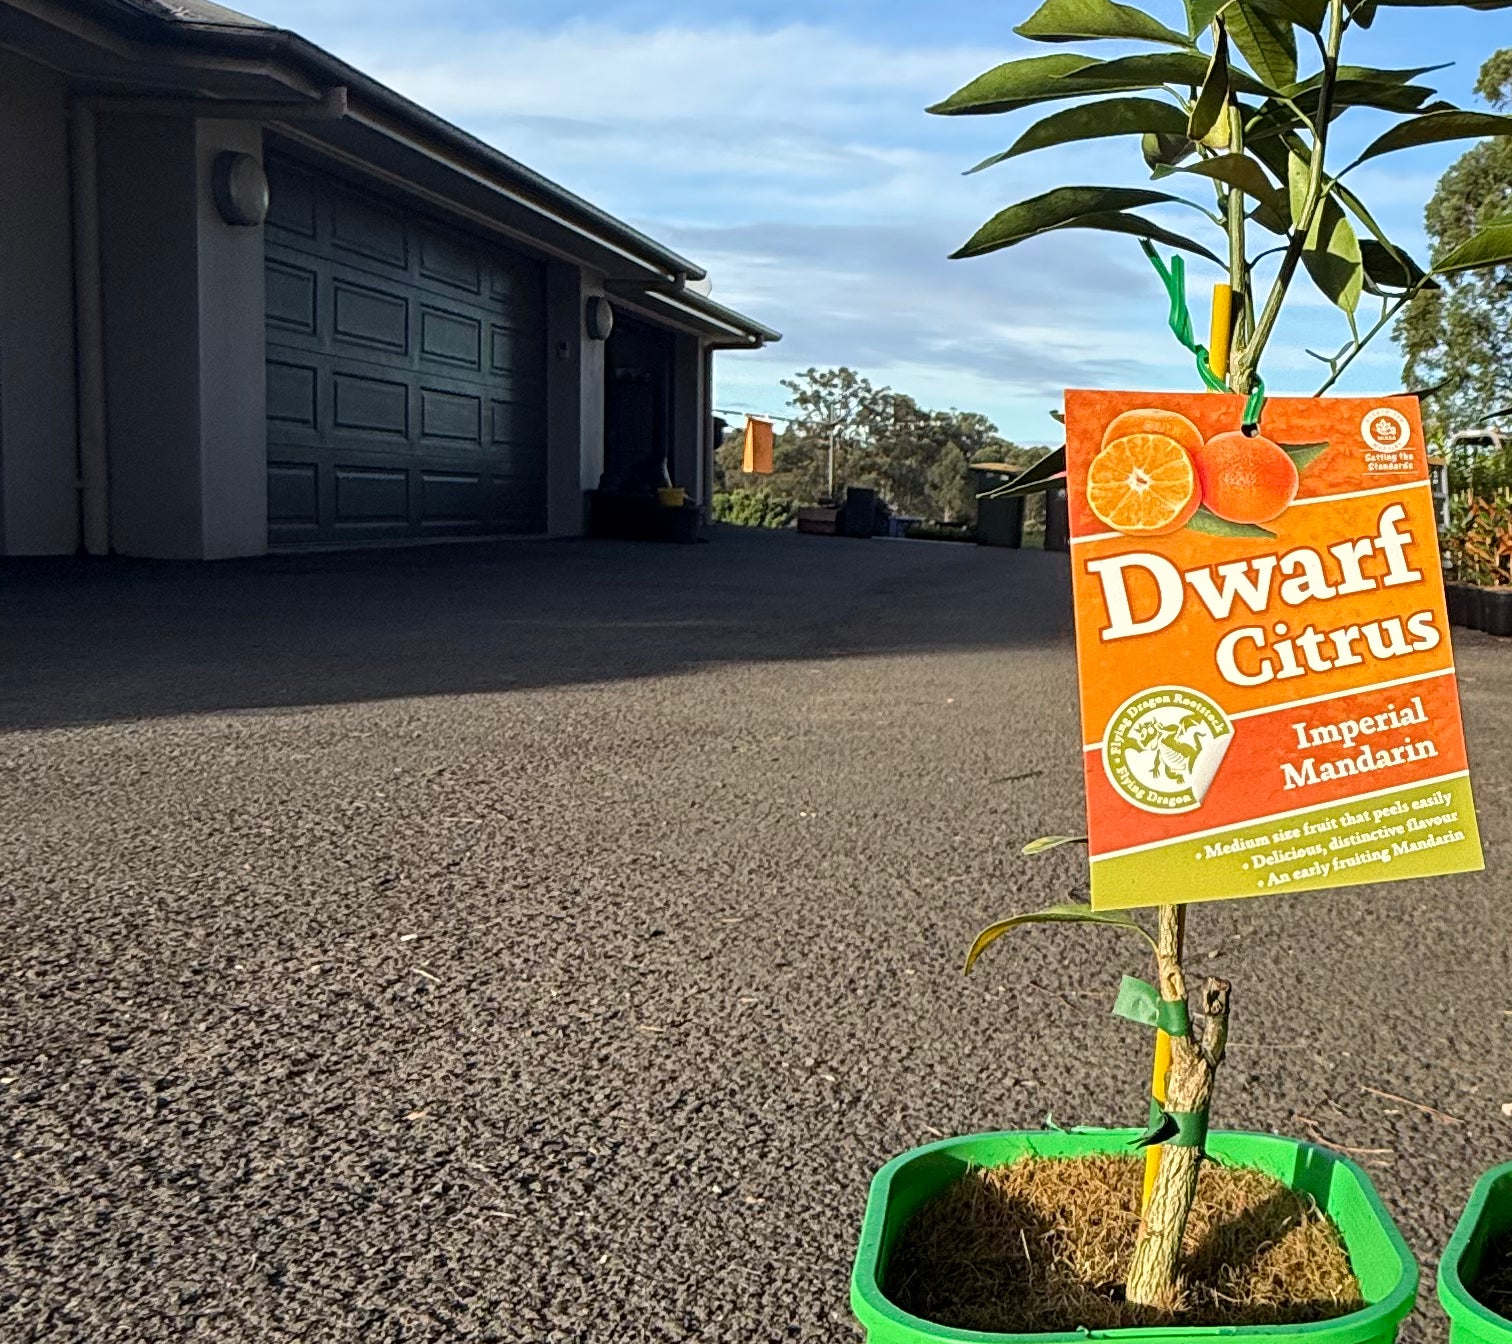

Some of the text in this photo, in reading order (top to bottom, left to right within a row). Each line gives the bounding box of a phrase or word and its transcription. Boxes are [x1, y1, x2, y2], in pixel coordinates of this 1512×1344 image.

[1086, 503, 1423, 642] Dwarf
[1215, 611, 1441, 687] Citrus
[1110, 693, 1225, 755] Flying Dragon Rootstock
[1292, 696, 1429, 749] Imperial
[1116, 765, 1192, 807] Flying Dragon
[1280, 737, 1439, 791] Mandarin
[1204, 791, 1452, 860] Medium size fruit that peels easily
[1251, 810, 1459, 869] Delicious, distinctive flavour
[1267, 830, 1466, 887] An early fruiting Mandarin
